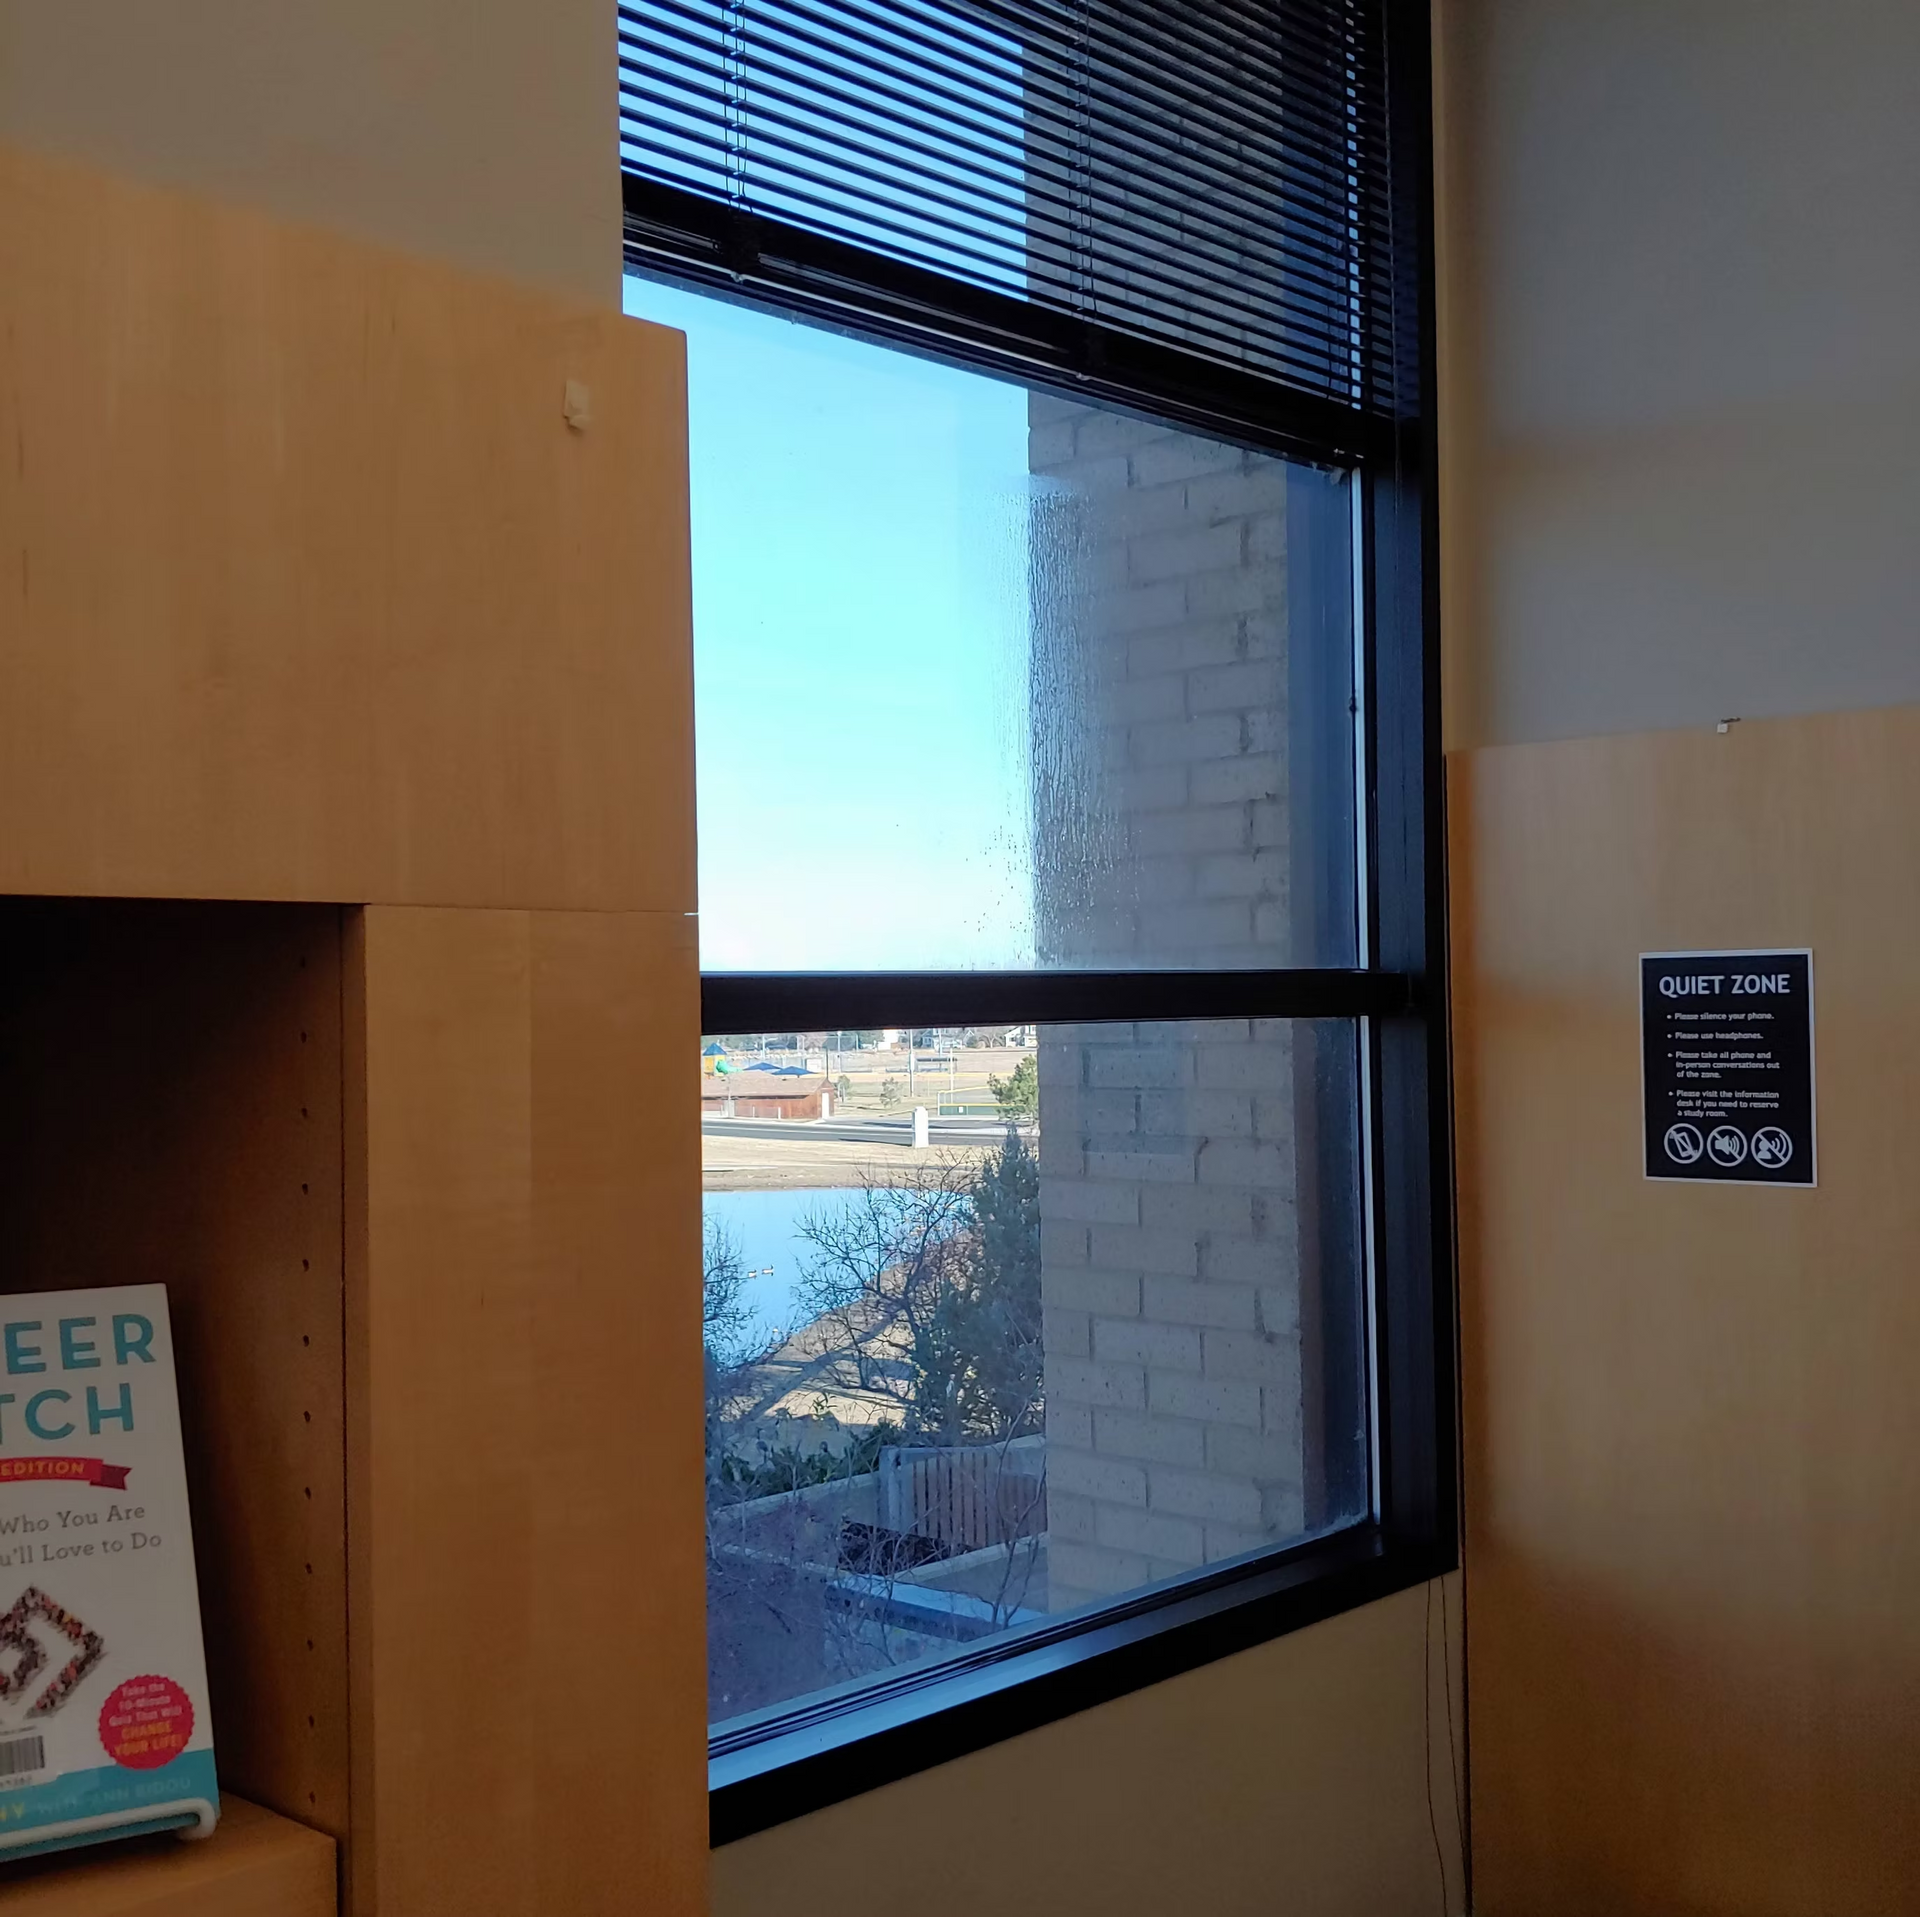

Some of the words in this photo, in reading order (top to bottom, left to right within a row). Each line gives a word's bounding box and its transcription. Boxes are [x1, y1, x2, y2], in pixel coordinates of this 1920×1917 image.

[1659, 975, 1725, 998] QUIET
[1731, 974, 1791, 994] ZONE
[1674, 1012, 1699, 1020] Please
[1700, 1012, 1727, 1020] silence
[1728, 1013, 1746, 1021] your
[1747, 1012, 1775, 1021] phone.
[1675, 1031, 1699, 1039] Please
[1715, 1031, 1764, 1041] headphones.
[1675, 1051, 1700, 1059] Please
[1701, 1051, 1718, 1059] take
[1719, 1051, 1730, 1059] all
[1730, 1051, 1755, 1060] phone
[1756, 1051, 1772, 1059] and
[1675, 1061, 1711, 1069] in-person
[1712, 1061, 1765, 1069] conversations
[1676, 1070, 1685, 1078] of
[1686, 1070, 1699, 1078] the
[1676, 1089, 1700, 1098] Please
[1702, 1090, 1719, 1098] visit
[1719, 1090, 1733, 1098] the
[1734, 1090, 1780, 1099] information
[1676, 1099, 1694, 1107] desk
[1695, 1099, 1701, 1107] if
[1702, 1101, 1717, 1109] you
[1718, 1100, 1738, 1108] need
[1739, 1100, 1748, 1108] to
[1749, 1101, 1780, 1109] reserve
[1684, 1109, 1704, 1118] study
[1705, 1110, 1729, 1118] room.
[4, 1313, 156, 1375] EER
[1, 1460, 85, 1477] EDITION
[0, 1513, 49, 1535] Who
[56, 1510, 99, 1529] You
[107, 1504, 145, 1523] Are
[42, 1543, 95, 1562] Love
[102, 1539, 124, 1554] to
[131, 1531, 162, 1550] Do
[121, 1685, 147, 1697] Take
[121, 1721, 172, 1740] CHANGE
[115, 1739, 149, 1756] YOUR
